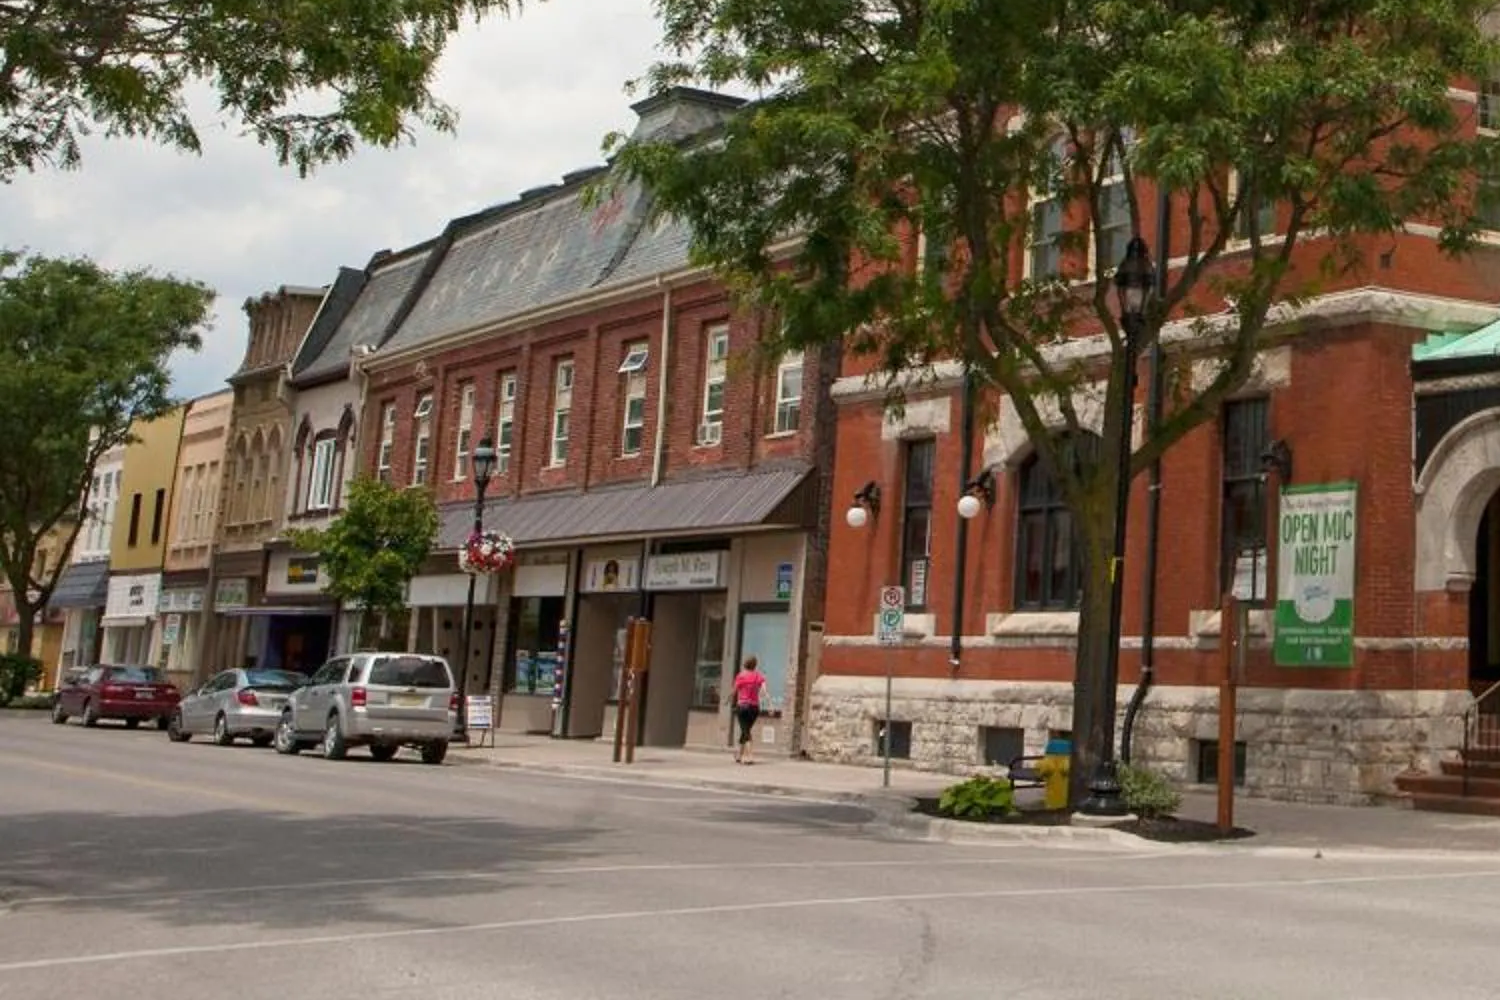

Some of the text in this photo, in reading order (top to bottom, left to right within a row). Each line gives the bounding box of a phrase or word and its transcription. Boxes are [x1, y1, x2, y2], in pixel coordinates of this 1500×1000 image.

[1282, 510, 1353, 544] OPEN MIC
[1294, 545, 1338, 576] NIGHT
